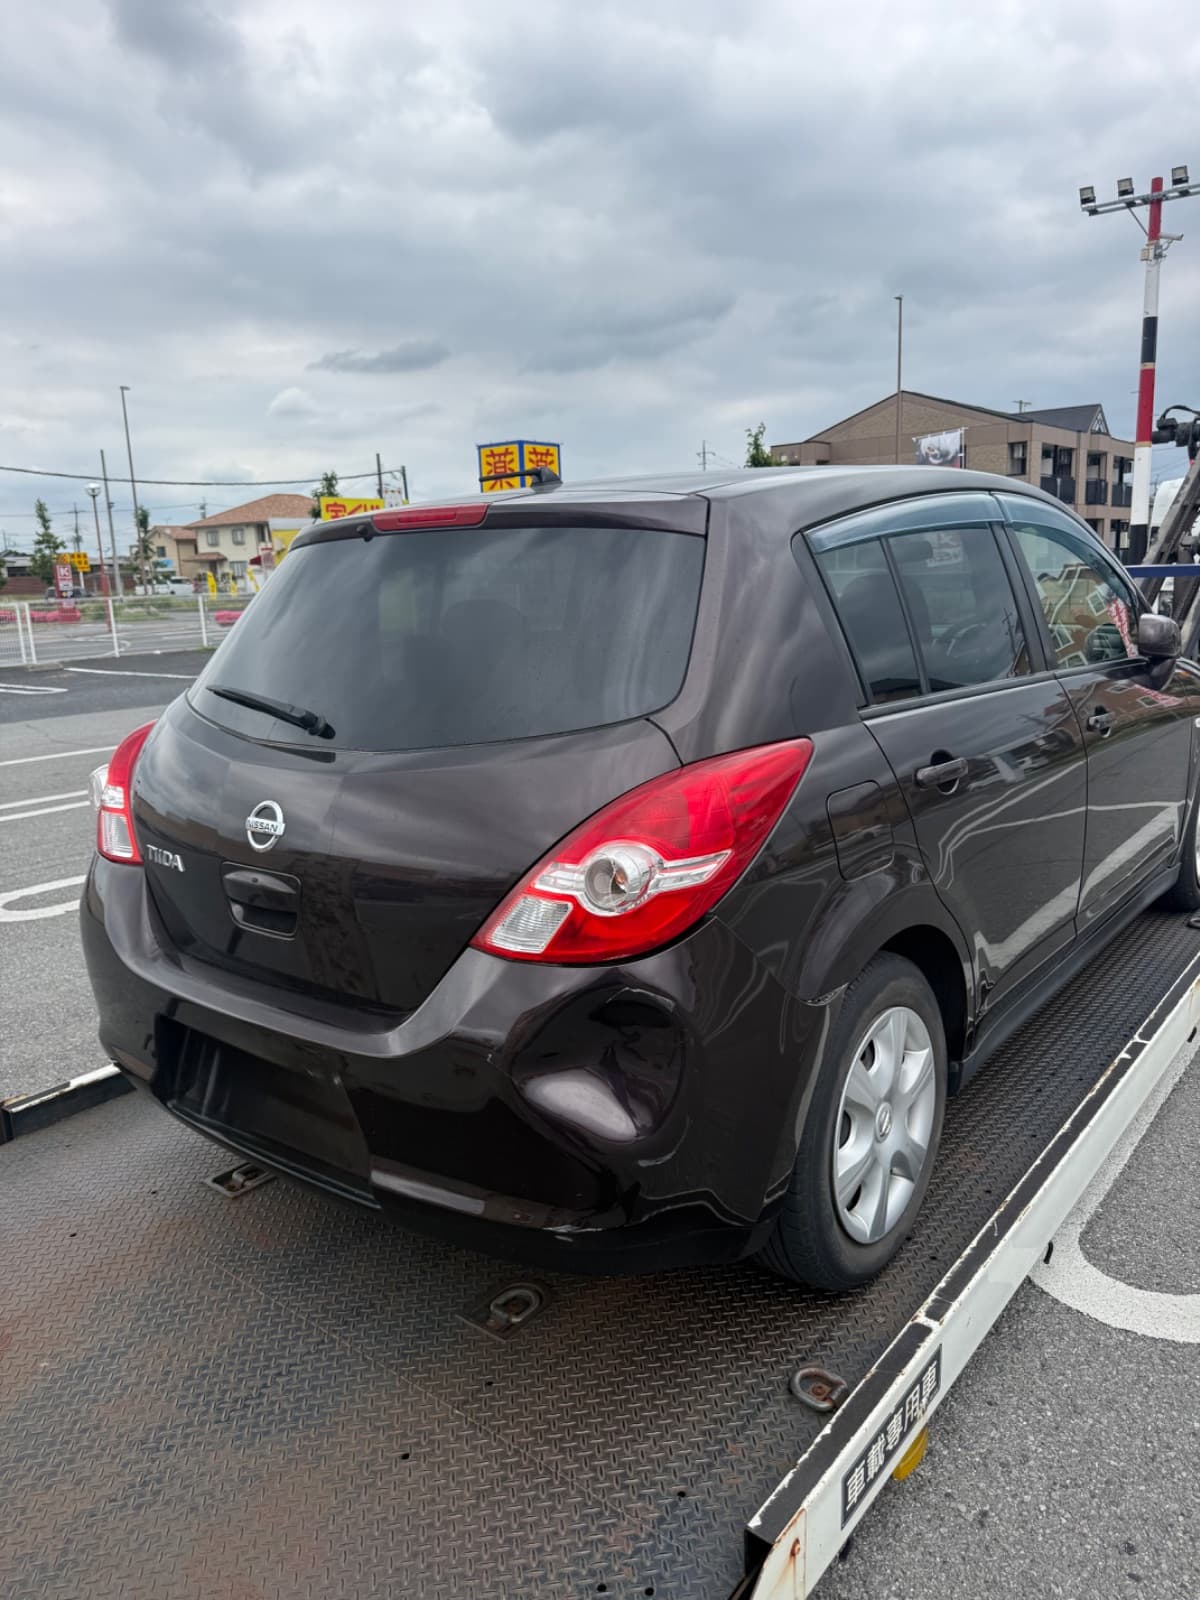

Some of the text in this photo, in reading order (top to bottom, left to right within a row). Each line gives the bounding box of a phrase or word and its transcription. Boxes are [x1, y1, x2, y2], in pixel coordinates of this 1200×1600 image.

[485, 447, 515, 490] 薬
[249, 820, 279, 833] NISSAN
[146, 844, 185, 872] TIIDA
[846, 1360, 937, 1511] 車載専用車
